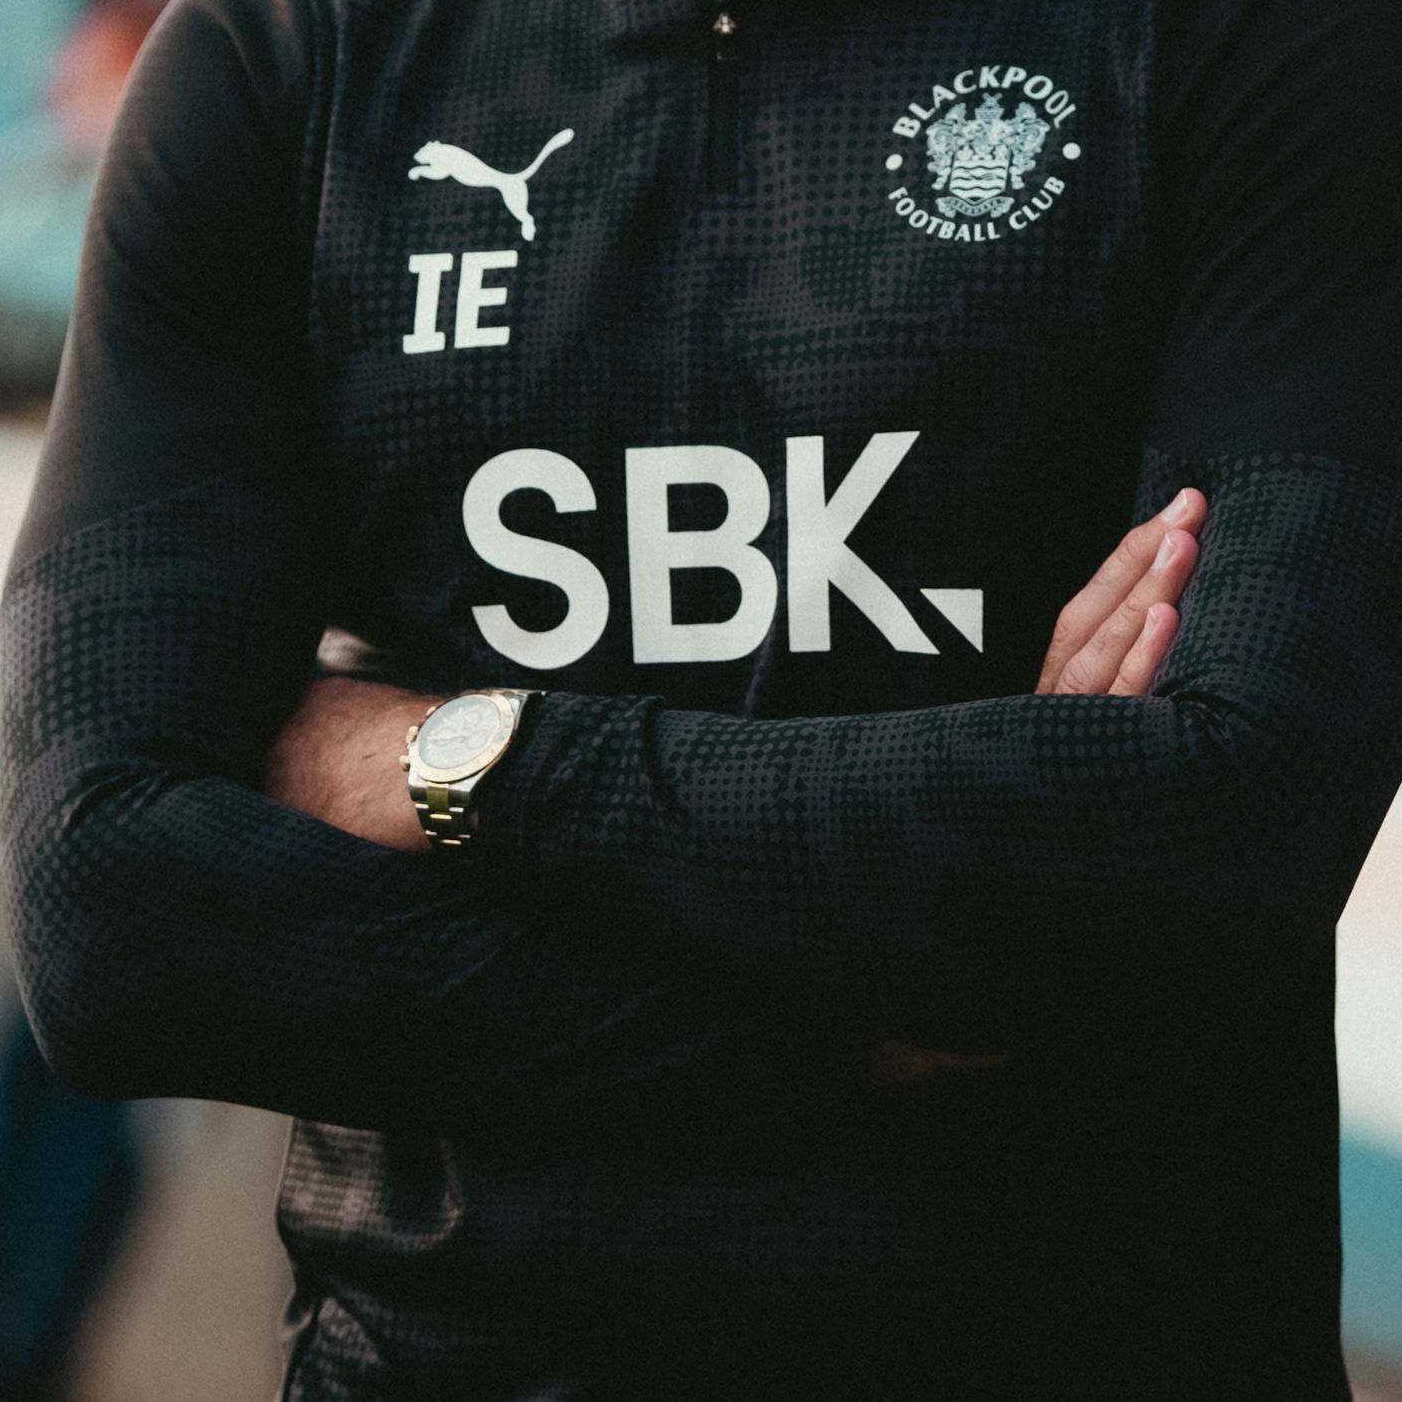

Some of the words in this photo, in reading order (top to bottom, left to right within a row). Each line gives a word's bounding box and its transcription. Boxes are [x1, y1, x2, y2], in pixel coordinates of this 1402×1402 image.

[892, 65, 1076, 138] BLACKPOOL
[888, 186, 1001, 242] FOOTBALL
[1008, 176, 1065, 230] CLUB
[402, 249, 519, 355] IE
[462, 430, 941, 670] SBK
